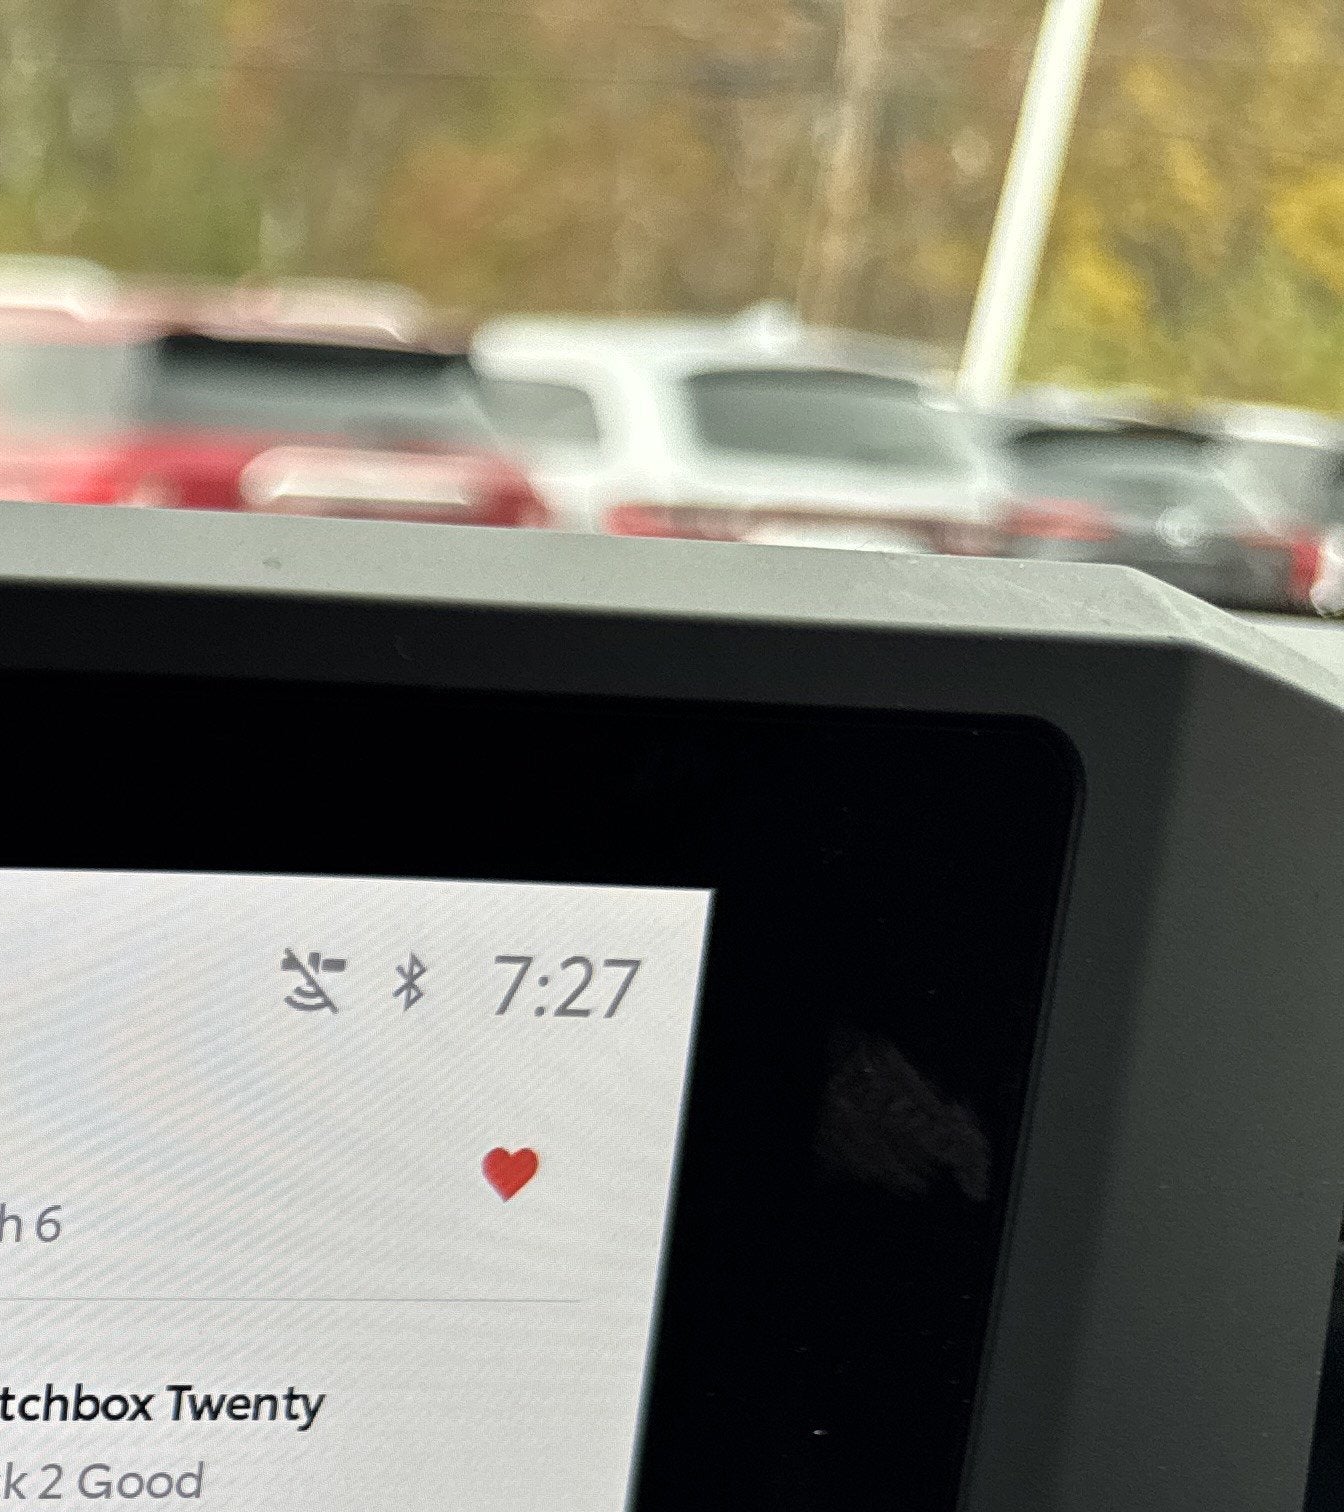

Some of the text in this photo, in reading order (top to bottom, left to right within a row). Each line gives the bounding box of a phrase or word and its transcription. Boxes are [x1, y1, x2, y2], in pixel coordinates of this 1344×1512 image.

[494, 955, 643, 1019] 7:27
[33, 1203, 62, 1246] 6
[165, 1385, 327, 1431] Twenty
[38, 1462, 64, 1502] 2
[77, 1462, 204, 1500] Good
